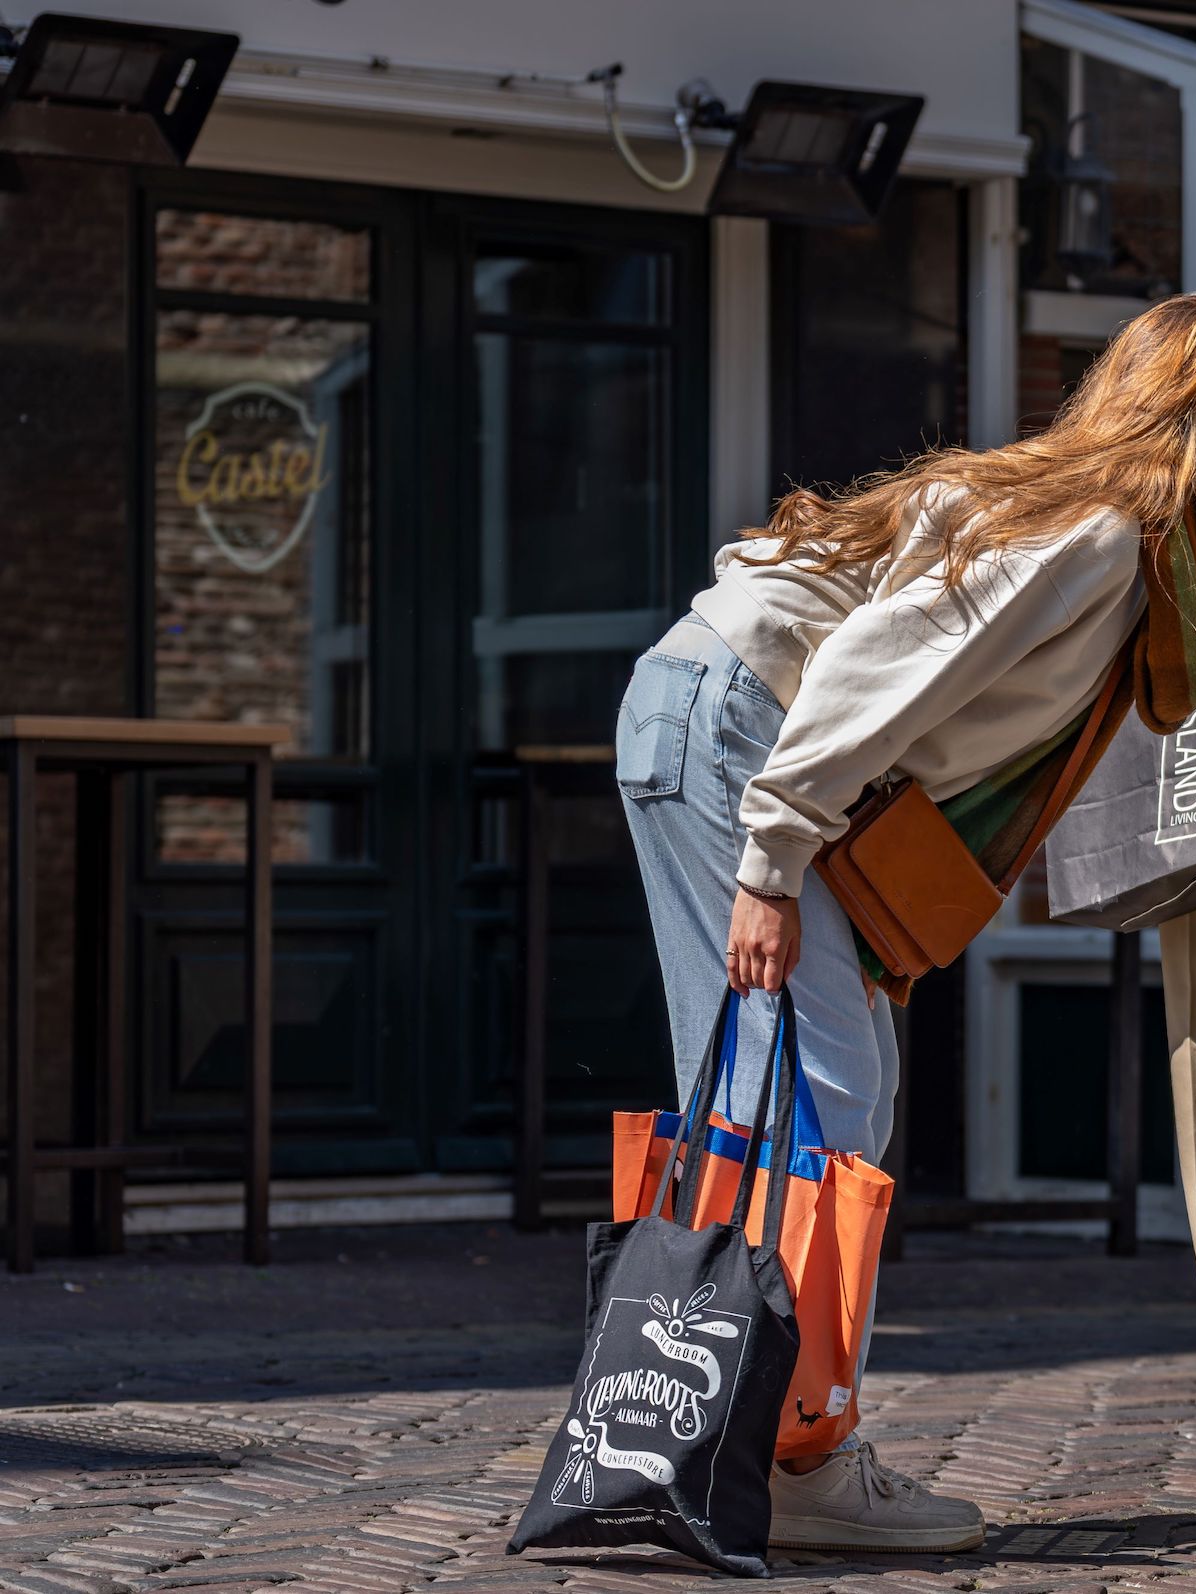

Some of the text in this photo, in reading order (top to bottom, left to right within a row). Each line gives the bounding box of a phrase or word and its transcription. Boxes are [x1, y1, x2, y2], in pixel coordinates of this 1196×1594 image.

[176, 421, 332, 506] Castel
[650, 1326, 709, 1364] LUNCHROOM
[602, 1452, 665, 1479] CONCEPTSTORE
